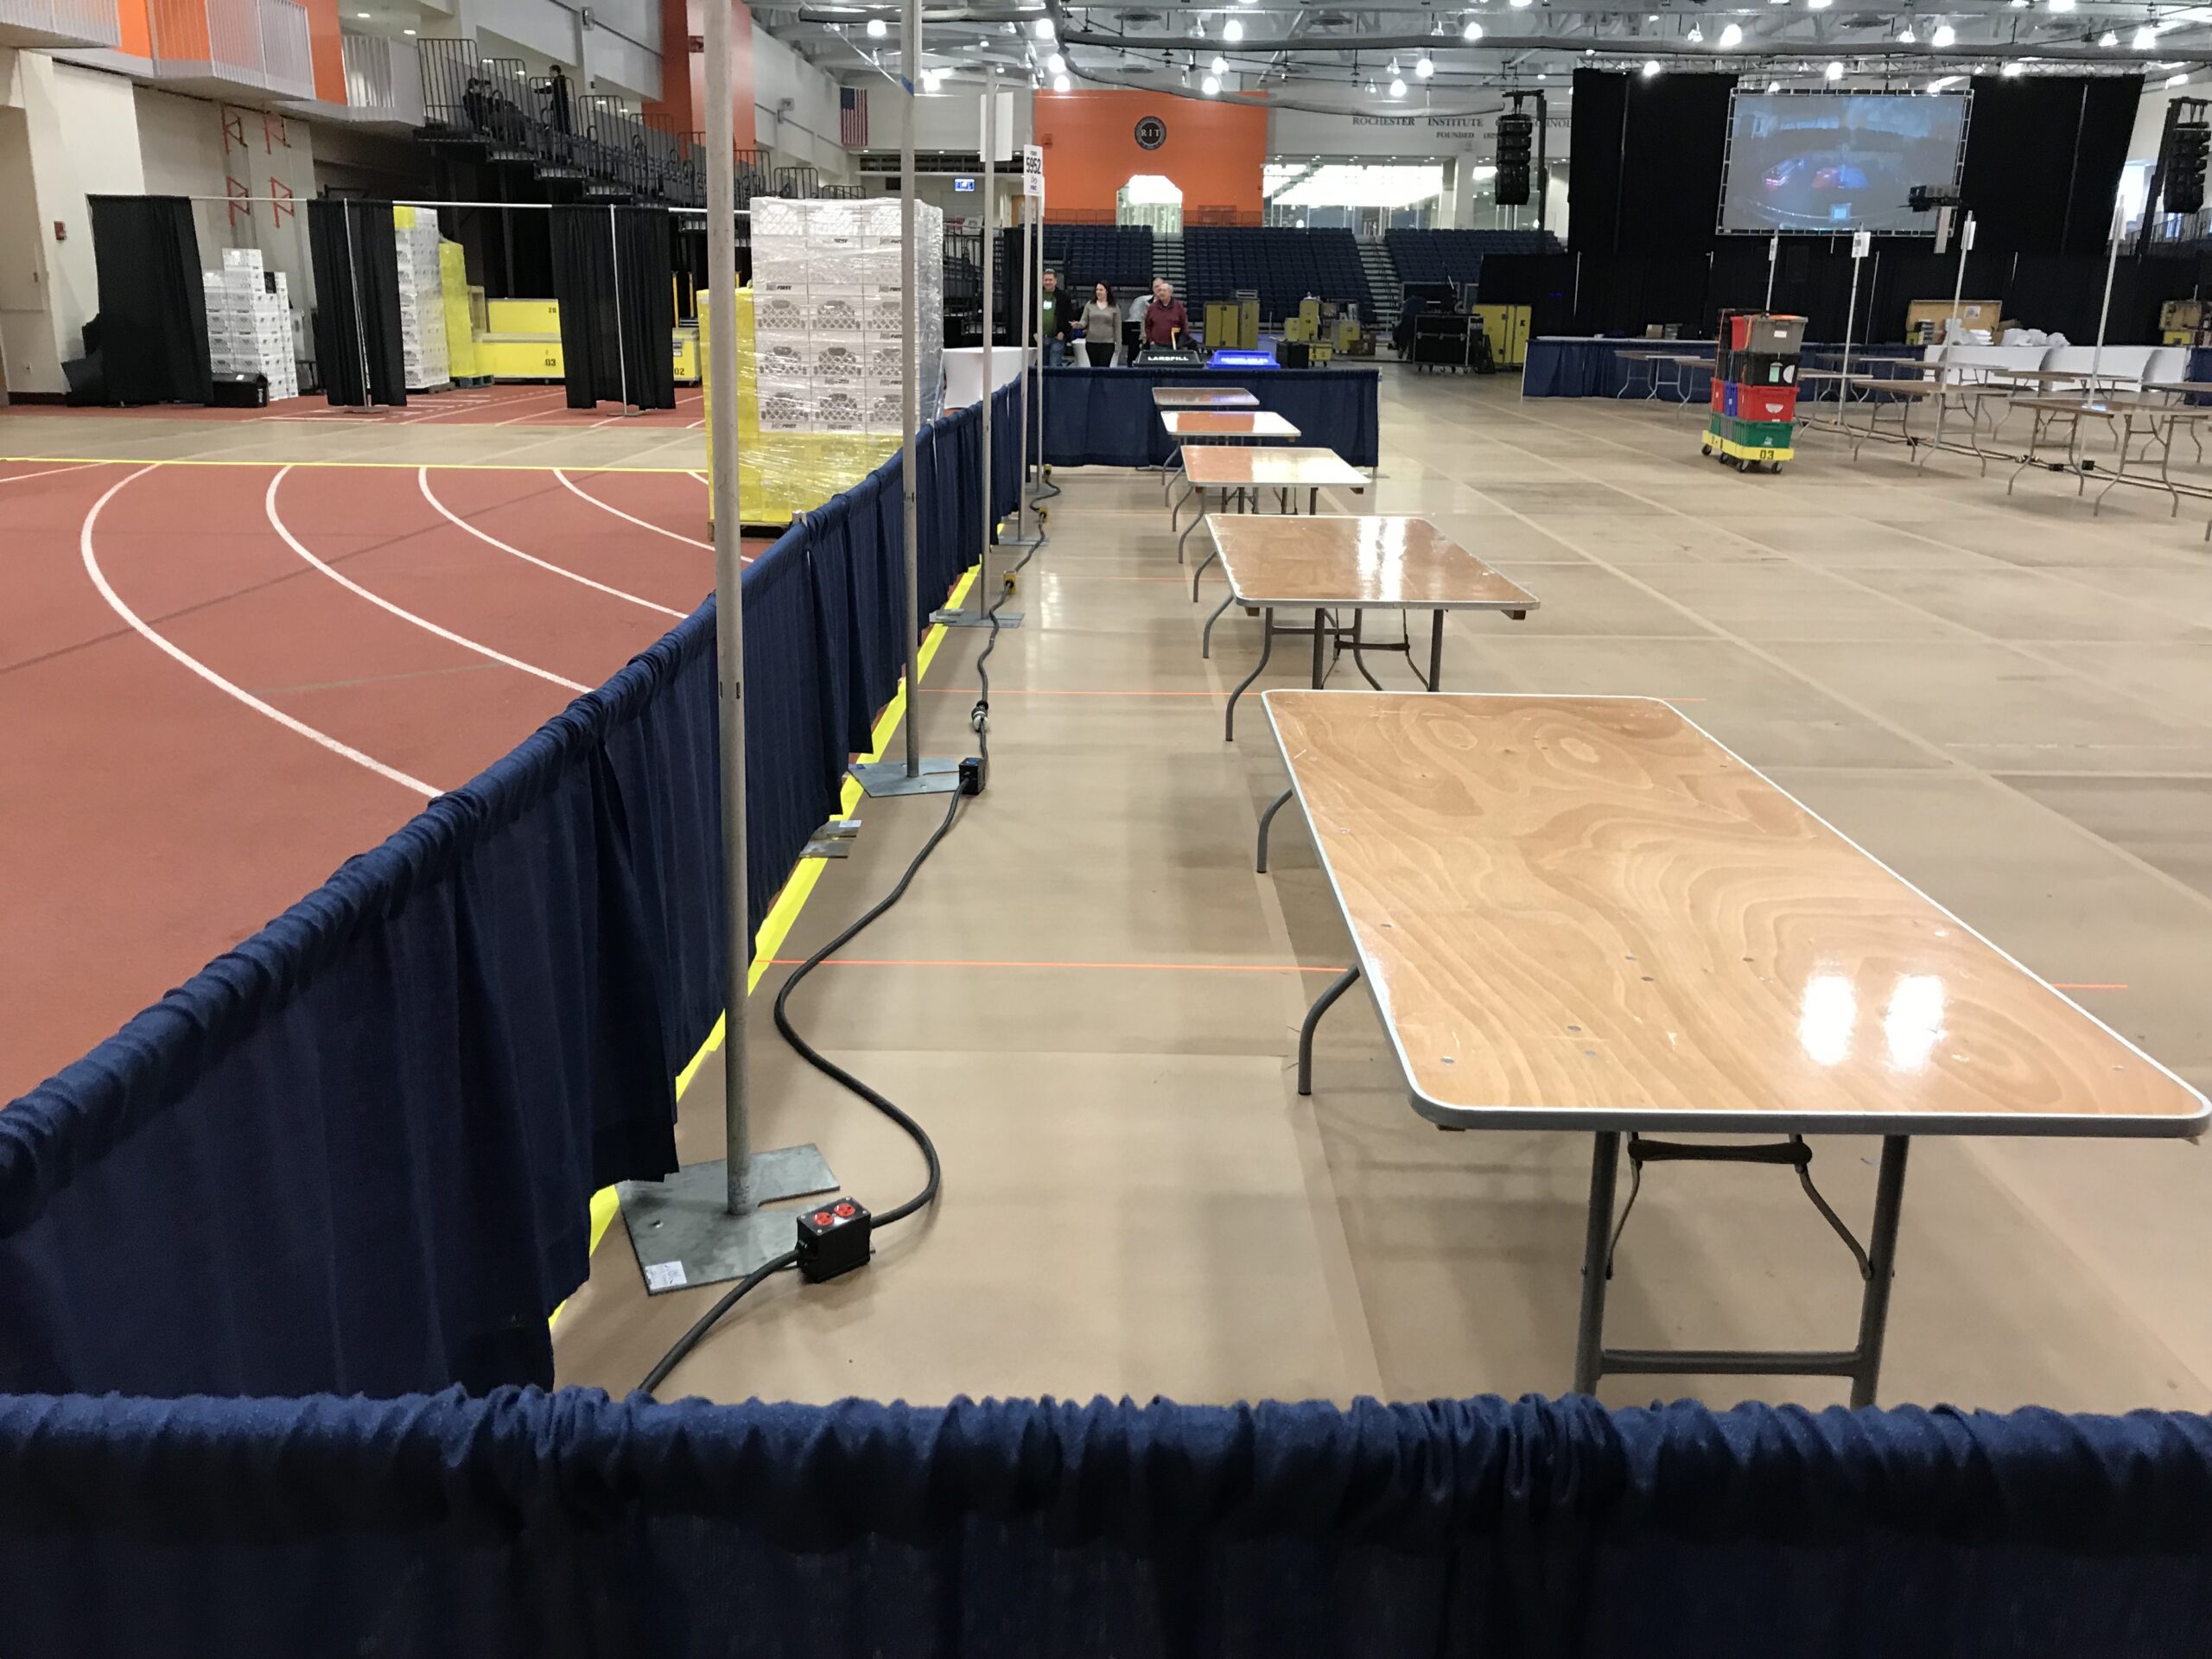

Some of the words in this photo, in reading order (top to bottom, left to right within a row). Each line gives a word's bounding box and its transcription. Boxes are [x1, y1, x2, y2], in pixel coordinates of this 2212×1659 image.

[1352, 117, 1415, 126] ROCHESTER
[1427, 118, 1484, 127] INSTITUTE
[1026, 156, 1041, 174] 5952
[1759, 449, 1774, 460] 03
